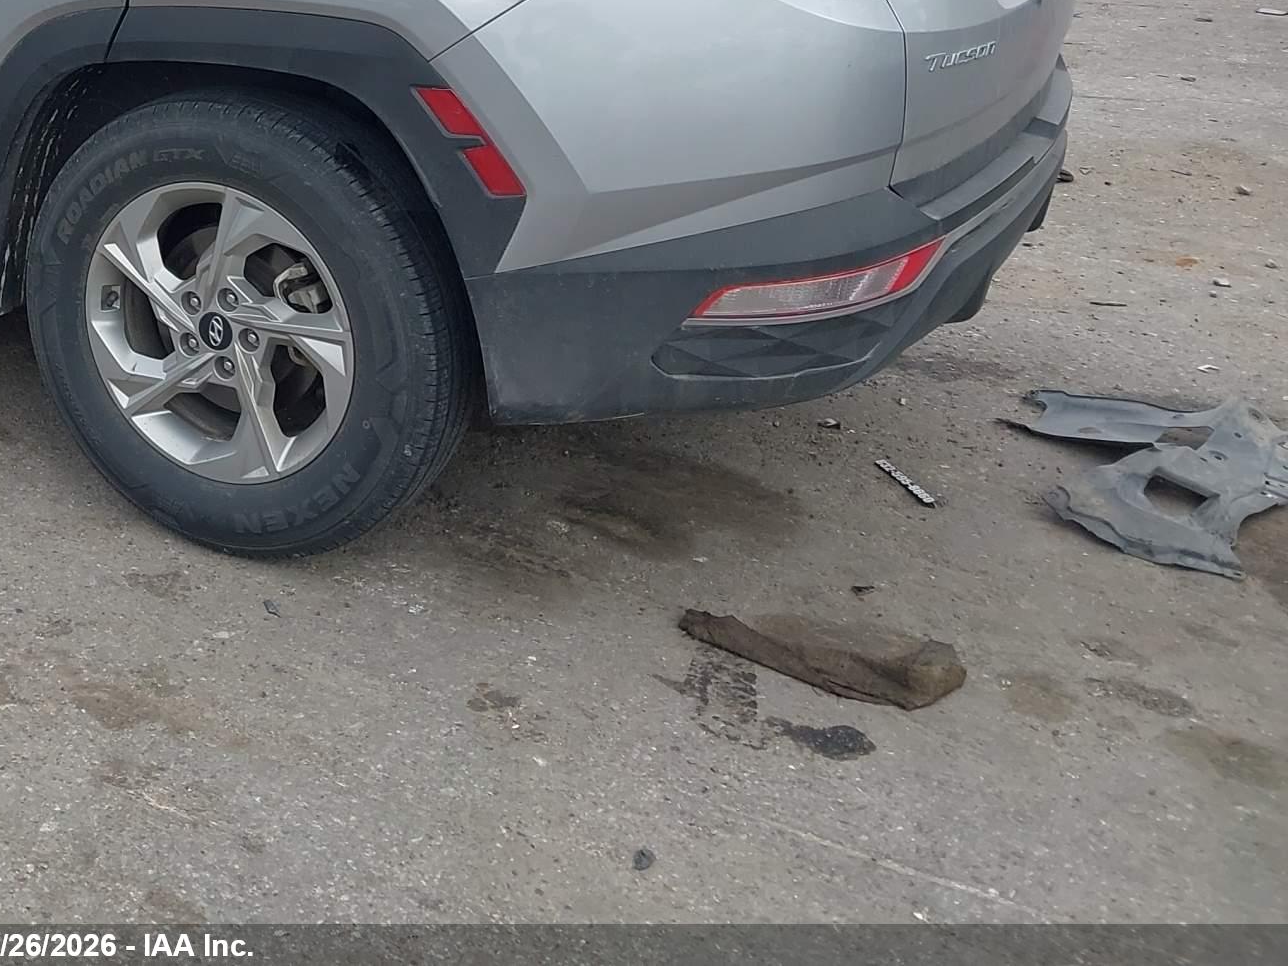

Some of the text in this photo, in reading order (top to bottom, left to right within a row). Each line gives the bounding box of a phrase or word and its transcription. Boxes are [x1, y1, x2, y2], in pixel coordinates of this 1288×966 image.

[57, 148, 205, 244] ROADIAN GTX
[233, 463, 361, 533] NEXEN
